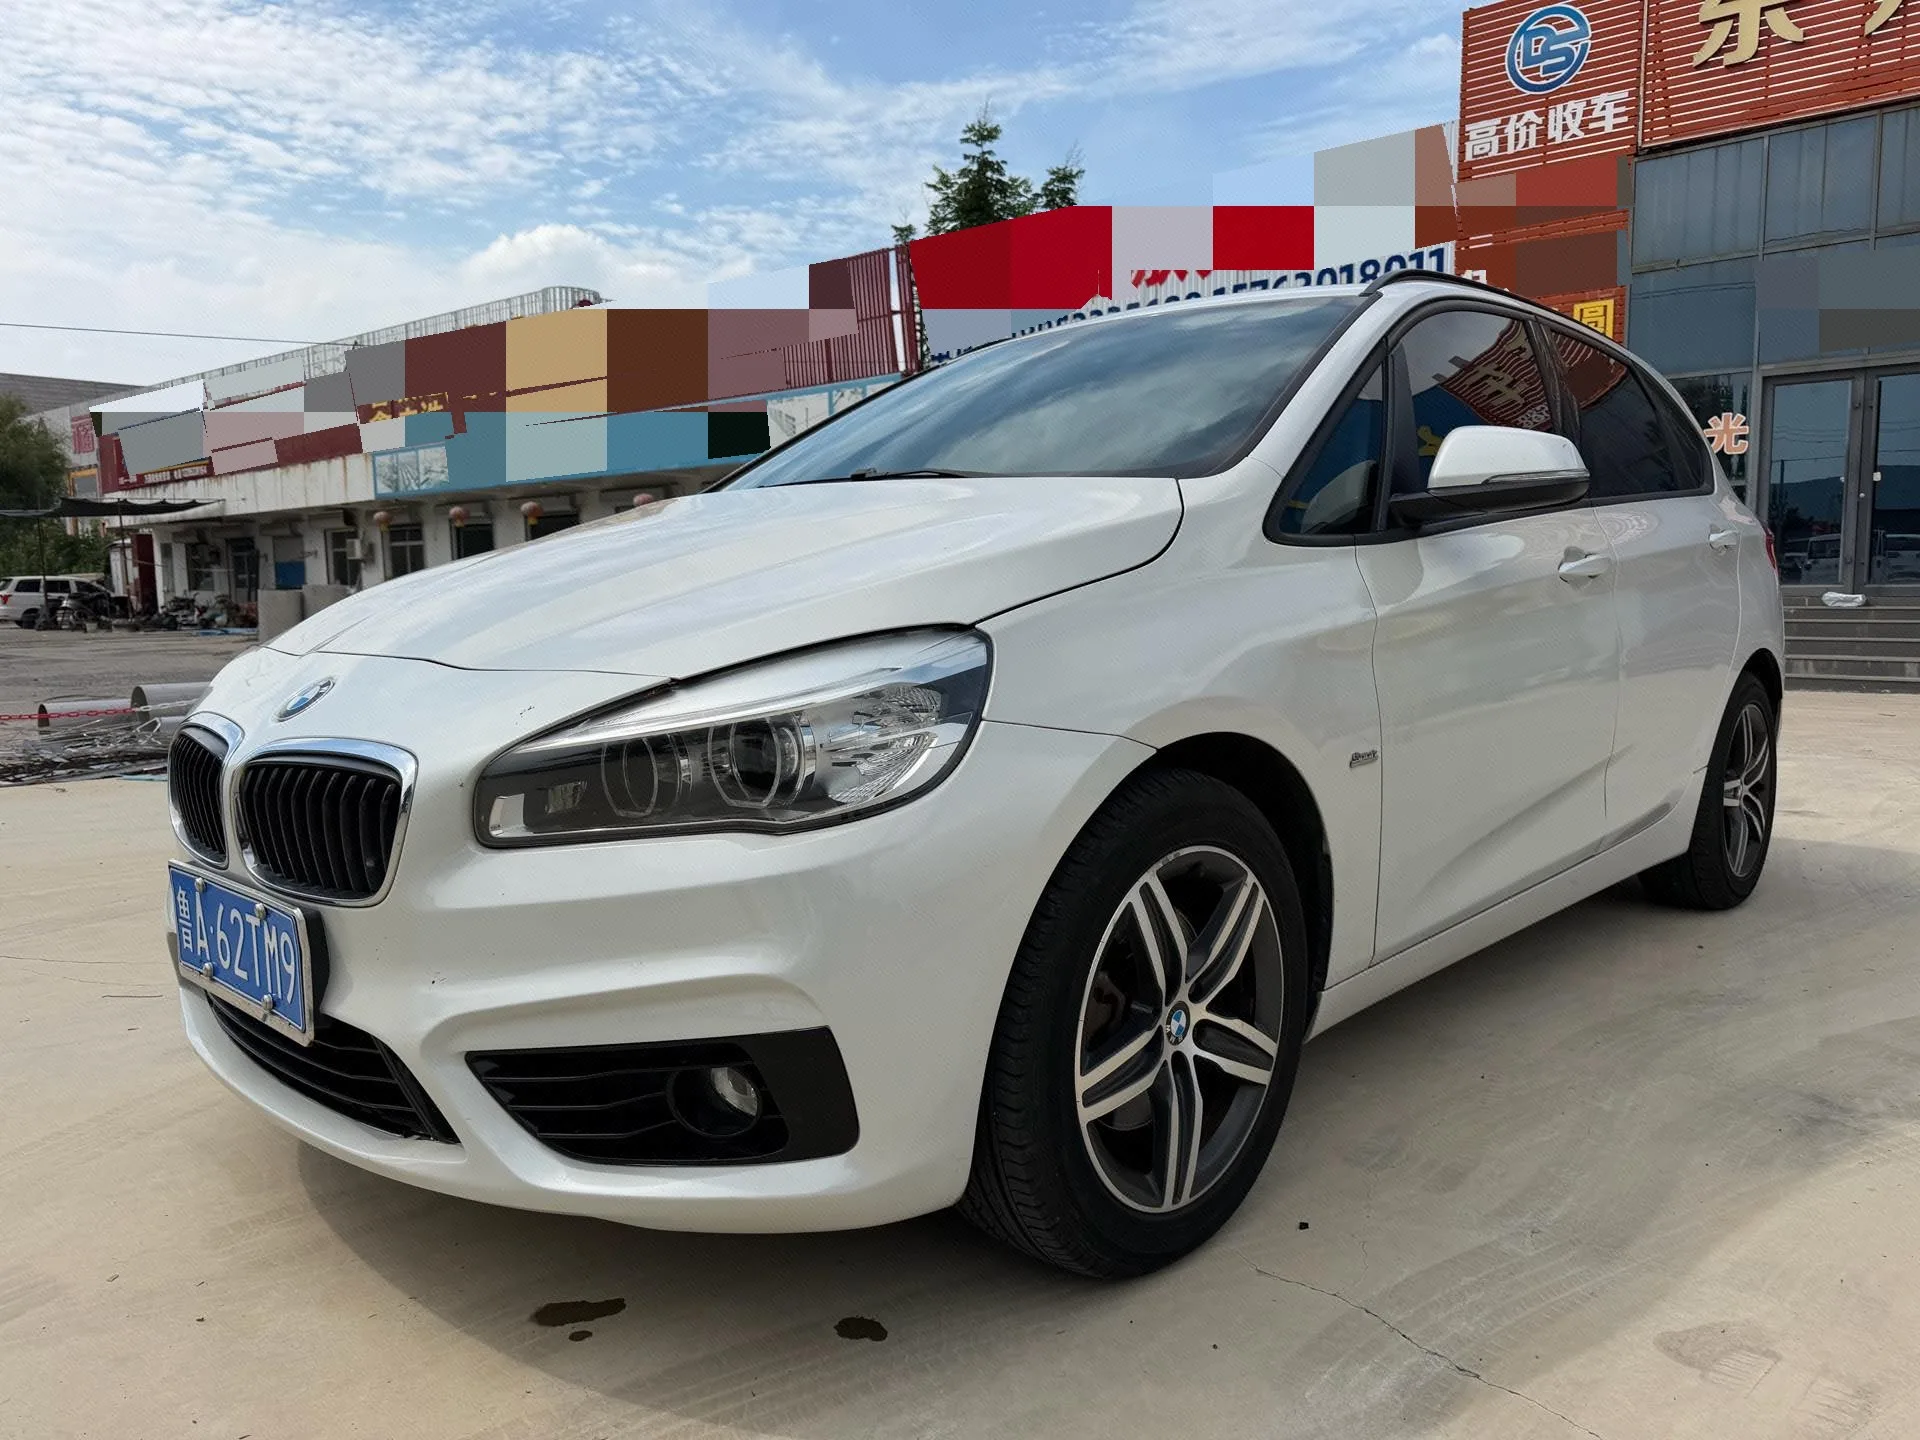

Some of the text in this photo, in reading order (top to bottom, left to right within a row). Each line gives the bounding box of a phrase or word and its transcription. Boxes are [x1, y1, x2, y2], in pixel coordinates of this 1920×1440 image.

[1464, 91, 1629, 162] 高价收车
[1213, 247, 1444, 296] 018011
[1703, 412, 1750, 455] 光
